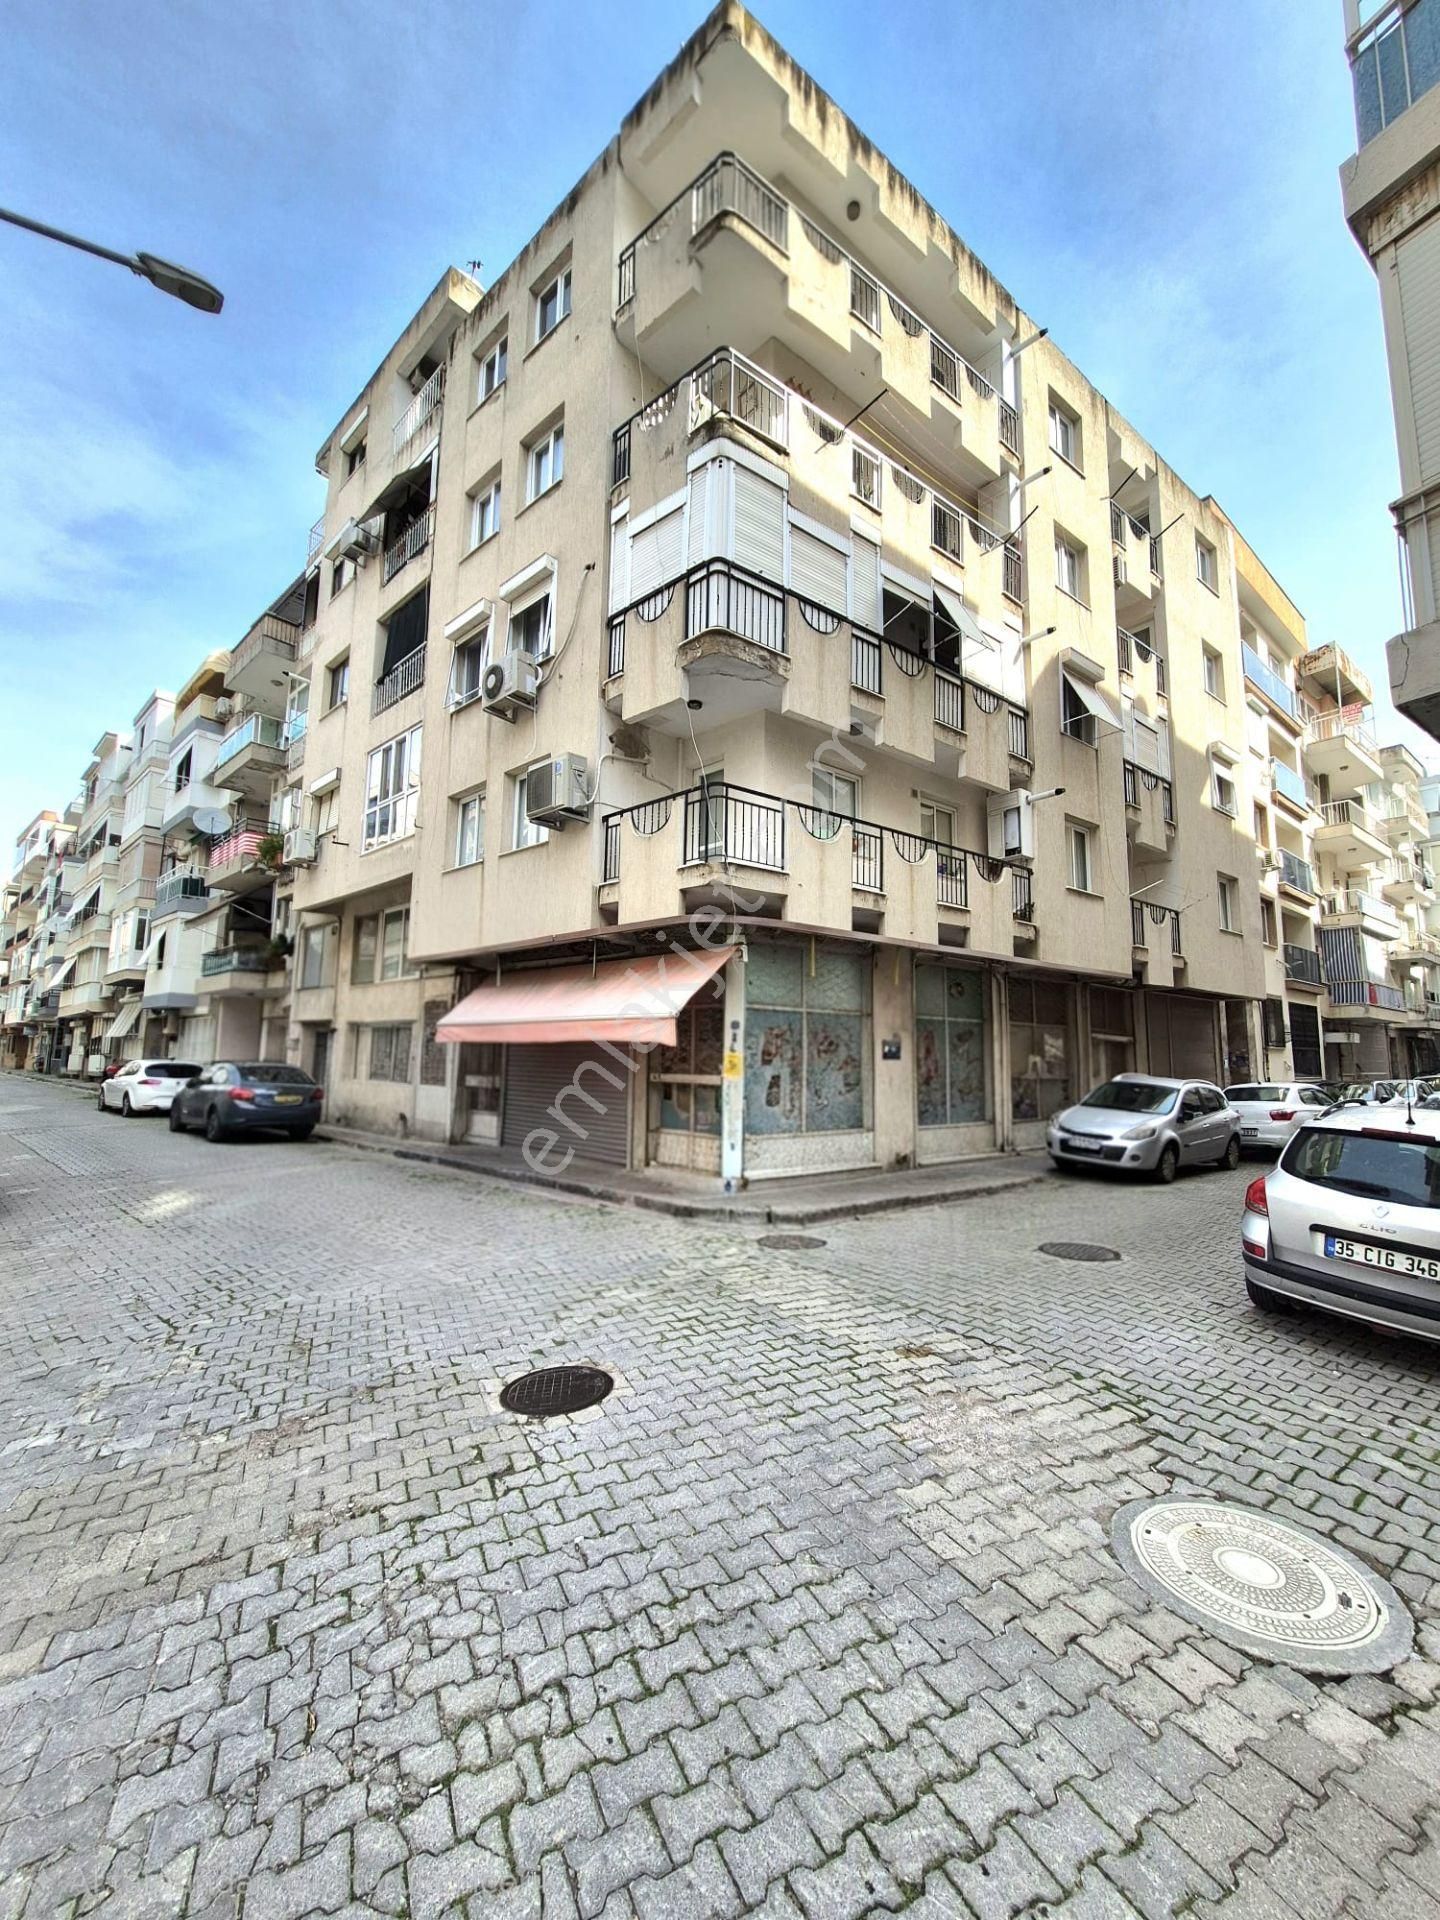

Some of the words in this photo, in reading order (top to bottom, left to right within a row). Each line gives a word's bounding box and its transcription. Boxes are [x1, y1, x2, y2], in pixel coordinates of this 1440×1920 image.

[1360, 1223, 1397, 1234] CLIO
[1336, 1241, 1354, 1257] 35
[1364, 1247, 1395, 1267] CIG
[1405, 1257, 1438, 1277] 346
